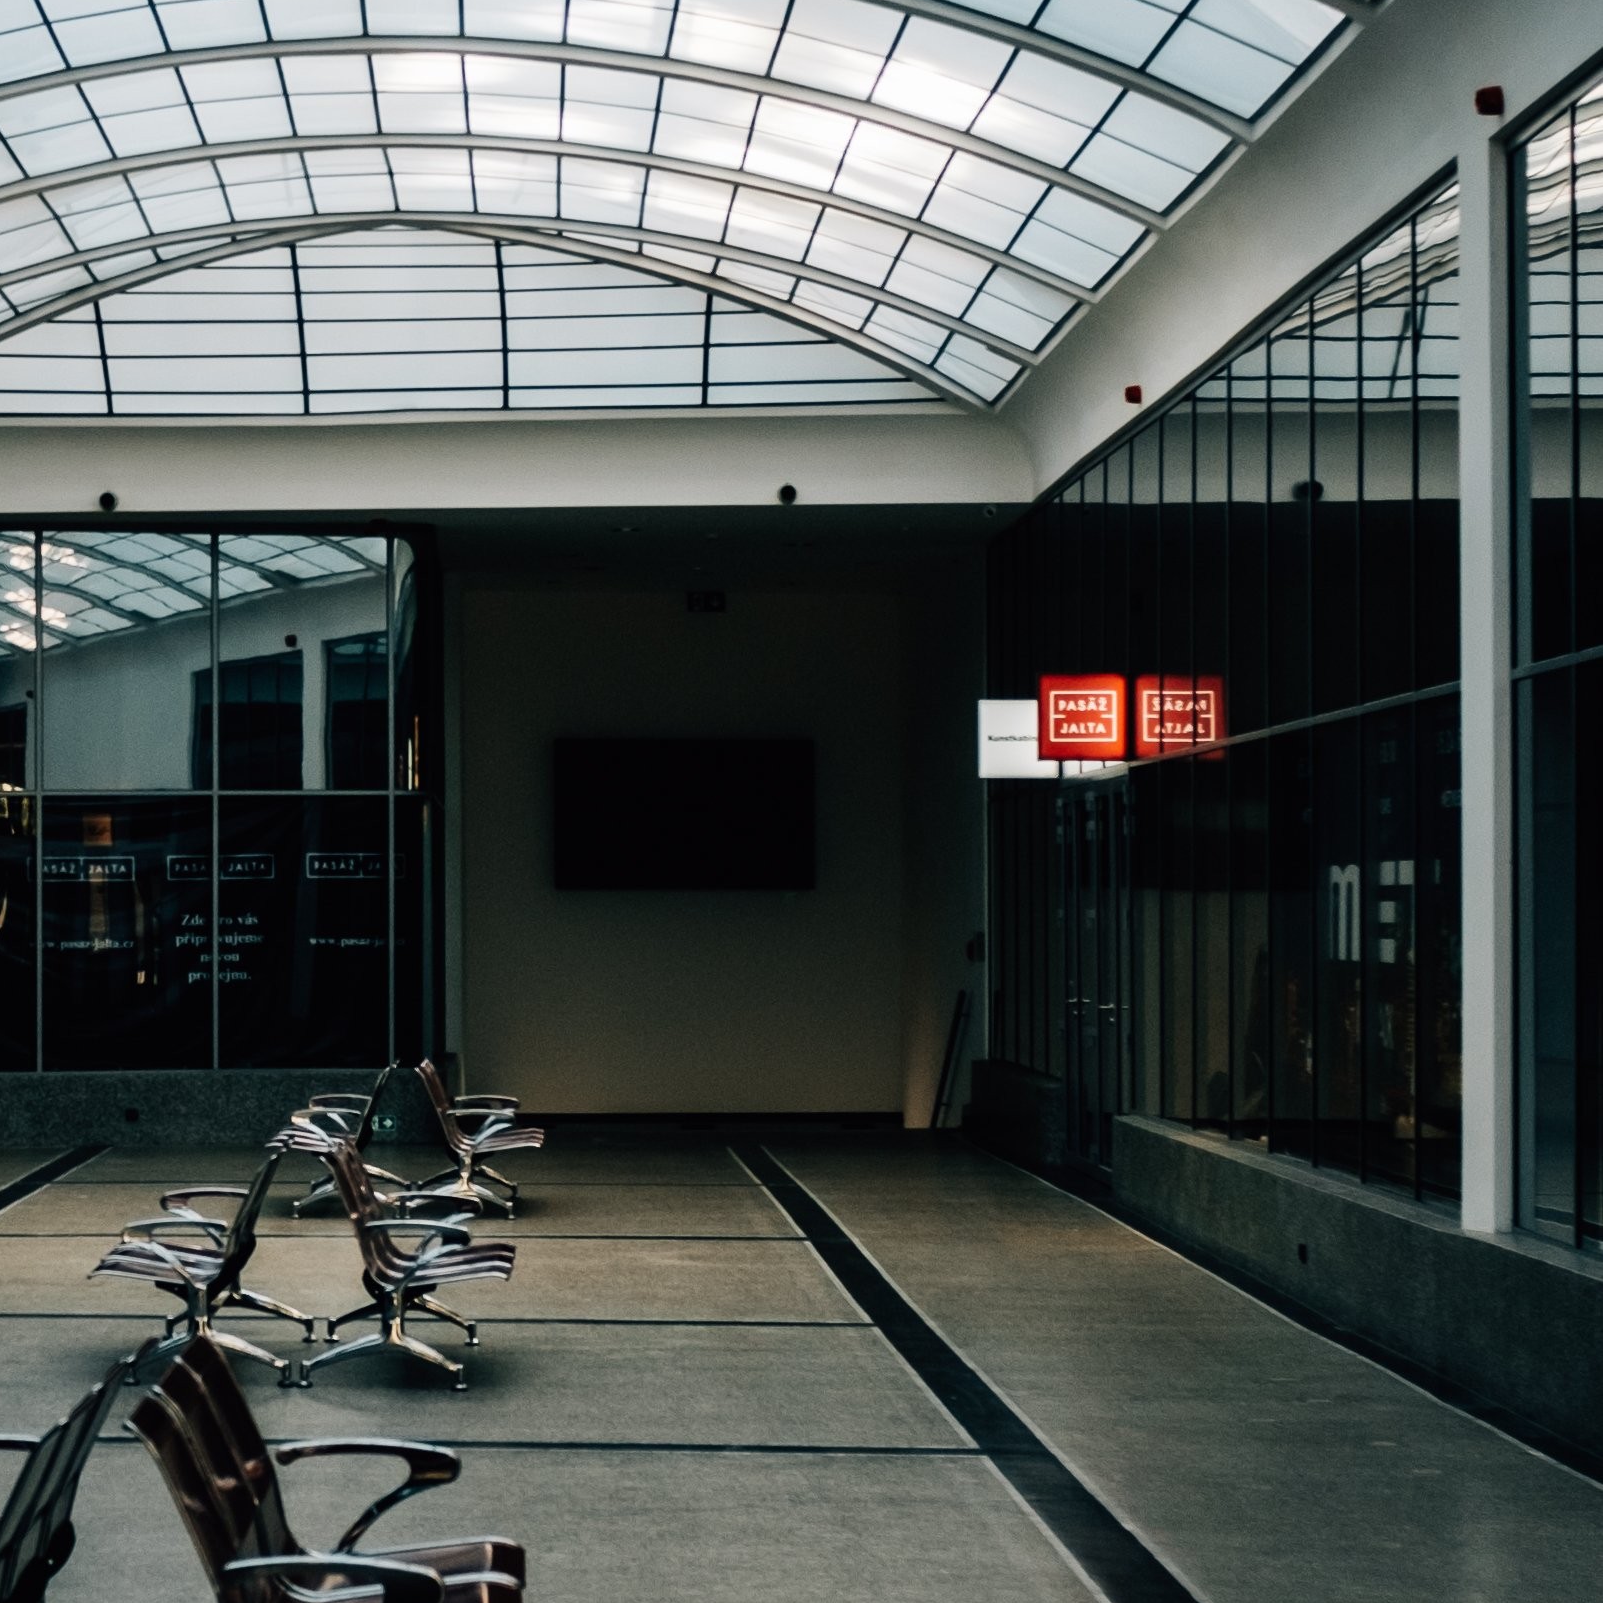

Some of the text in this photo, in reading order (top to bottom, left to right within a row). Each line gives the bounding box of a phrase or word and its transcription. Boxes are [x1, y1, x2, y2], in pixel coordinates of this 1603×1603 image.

[1060, 722, 1106, 734] JALTA
[41, 860, 77, 874] ASÁŽ
[228, 862, 266, 873] JALTA
[181, 914, 206, 927] Zde
[237, 912, 259, 926] vás
[175, 933, 264, 948] připrvujeme
[188, 968, 252, 984] proejnu.
